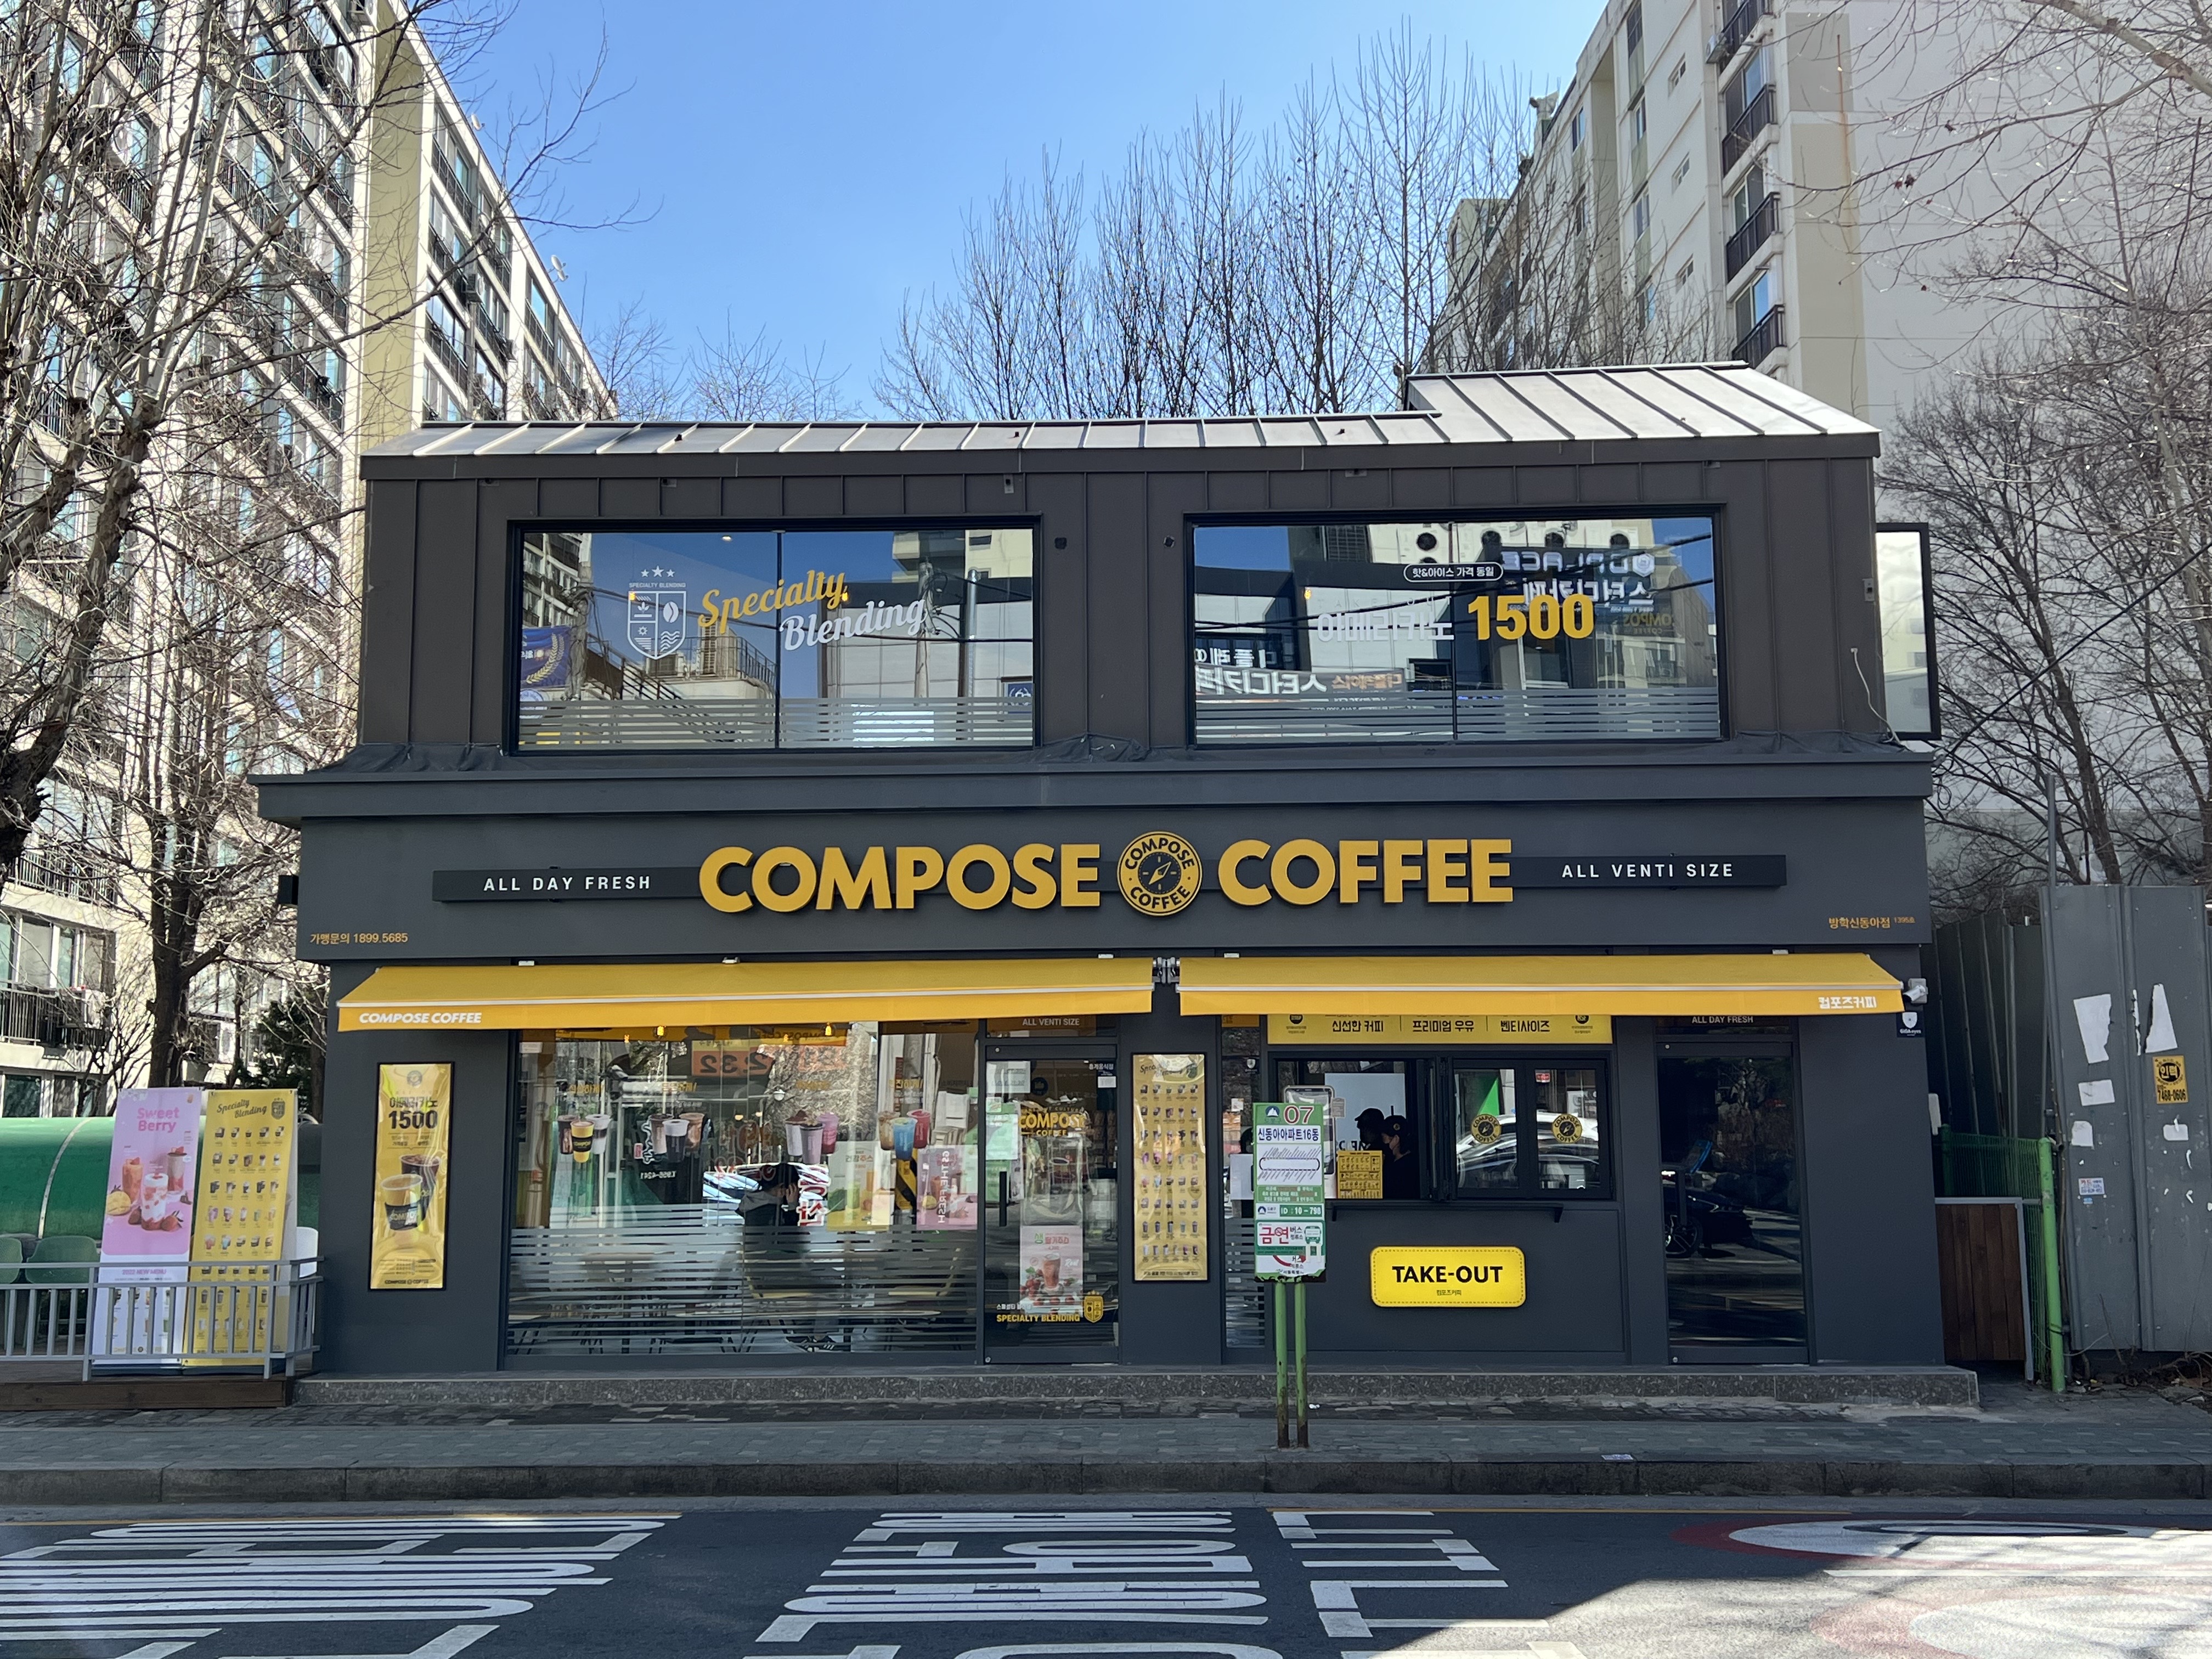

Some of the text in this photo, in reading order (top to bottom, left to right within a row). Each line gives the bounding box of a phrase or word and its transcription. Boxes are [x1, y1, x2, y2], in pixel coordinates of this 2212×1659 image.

[1412, 565, 1494, 579] 핫&아이스 가격 동일
[697, 569, 845, 634] Specialty
[1468, 593, 1595, 641] 1500
[780, 599, 927, 651] Blending
[1317, 611, 1454, 642] 아메리카노
[1125, 837, 1195, 871] COMPOSE
[1217, 838, 1514, 906] COFFEE
[1562, 863, 1733, 878] ALL VENTI SIZE
[484, 876, 651, 891] ALL DAY FRESH
[698, 843, 1101, 913] COMPOSE
[1129, 885, 1191, 910] COFFEE
[1829, 916, 1891, 929] 방학신동아점
[310, 932, 408, 945] 가맹문의 1899.5685
[1818, 996, 1877, 1009] 컴포즈커피
[359, 1012, 482, 1024] COMPOSE COFFEE
[1332, 1019, 1384, 1033] 신선한 커피
[1412, 1019, 1474, 1033] 프리미엄 우유
[1500, 1020, 1550, 1033] 벤티사이즈
[137, 1107, 179, 1121] Sweet
[217, 1099, 250, 1115] Specialty
[234, 1105, 267, 1119] Blending
[388, 1110, 438, 1130] 1500
[1284, 1105, 1314, 1125] 07
[1473, 1115, 1499, 1128] COMPOSE
[1554, 1115, 1580, 1128] COMPOSE
[138, 1119, 176, 1133] Berry
[1258, 1127, 1319, 1142] 신동아아파트16동
[1475, 1133, 1498, 1143] COFFEE
[1556, 1133, 1579, 1143] COFFEE
[1259, 1226, 1289, 1244] 금연
[1392, 1266, 1503, 1283] TAKE-OUT
[996, 1313, 1081, 1323] SPECIALTY BLENDING
